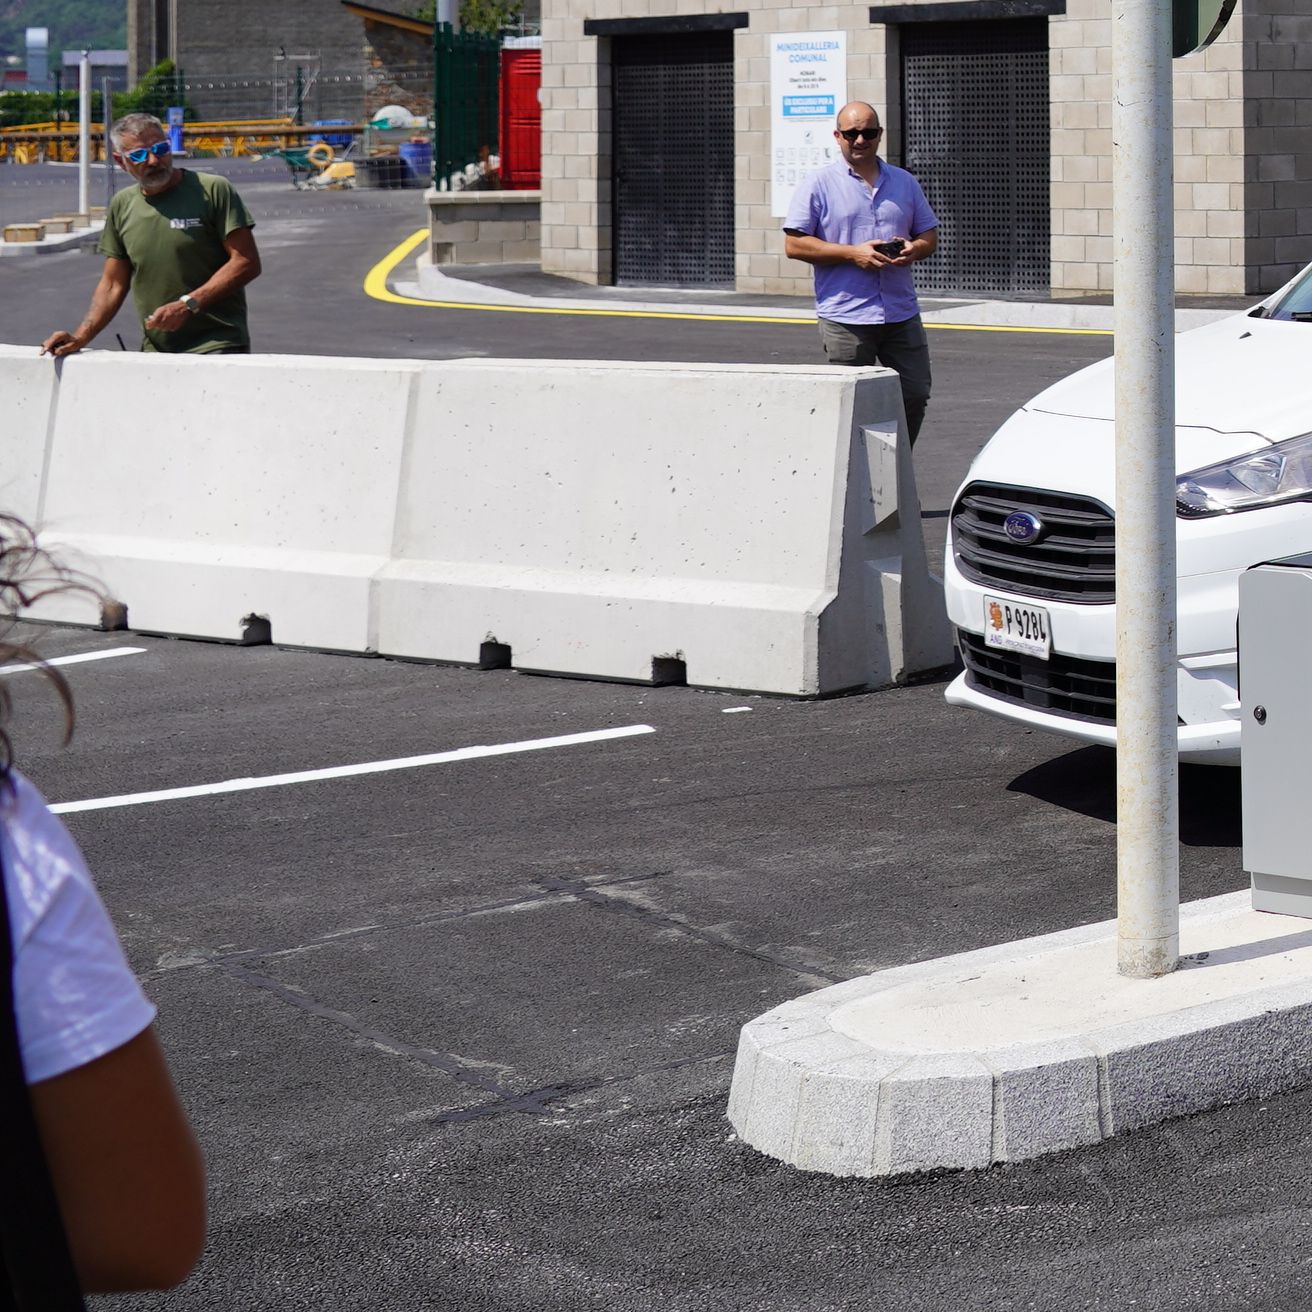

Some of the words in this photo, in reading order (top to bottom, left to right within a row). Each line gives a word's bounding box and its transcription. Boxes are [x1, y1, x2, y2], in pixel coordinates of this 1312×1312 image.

[789, 54, 827, 63] COMUNAL
[1005, 605, 1012, 634] P
[1015, 608, 1046, 643] 9284
